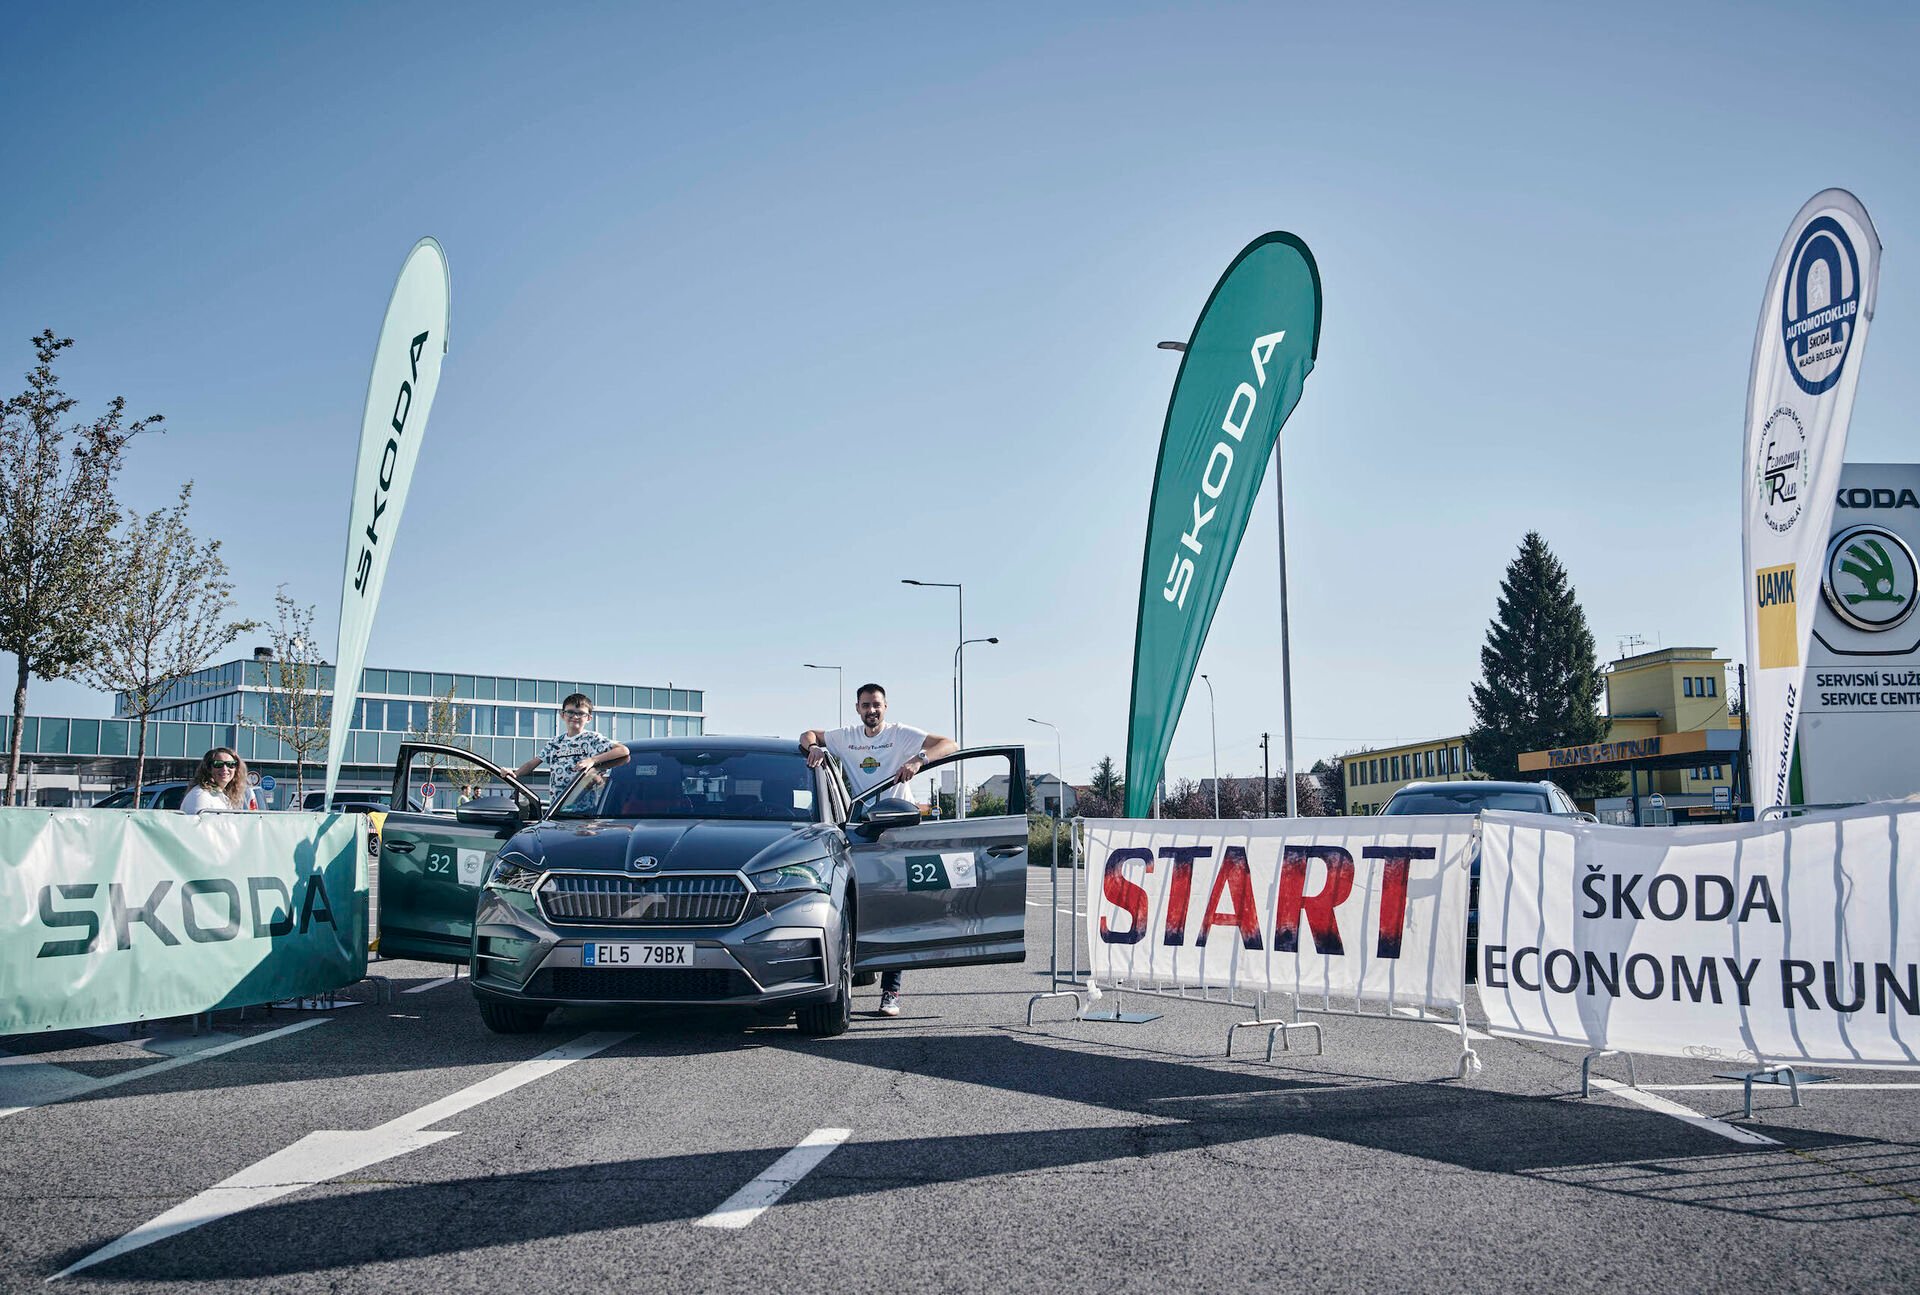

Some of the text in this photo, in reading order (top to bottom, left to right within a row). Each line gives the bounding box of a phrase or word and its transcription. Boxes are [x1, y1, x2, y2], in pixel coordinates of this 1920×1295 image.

[1787, 301, 1857, 340] AUTOMOTOKLUB
[1809, 332, 1830, 349] ŠKODA
[1816, 346, 1843, 362] BOLESLAV
[1759, 407, 1792, 456] OMOTOKLUB
[1765, 441, 1800, 473] Economy
[1765, 473, 1797, 506] Run
[1836, 488, 1920, 509] KODA
[1779, 503, 1802, 533] BOLESLAV
[1757, 569, 1795, 608] UAMK
[1816, 671, 1879, 687] SERVISNÍ
[1821, 692, 1877, 706] SERVICE
[428, 853, 451, 874] 32
[911, 863, 938, 883] 32
[1100, 845, 1436, 959] START
[1581, 864, 1782, 923] ŠKODA
[598, 946, 685, 963] EL5 79BX
[1484, 944, 1920, 1016] ECONOMY RUN
